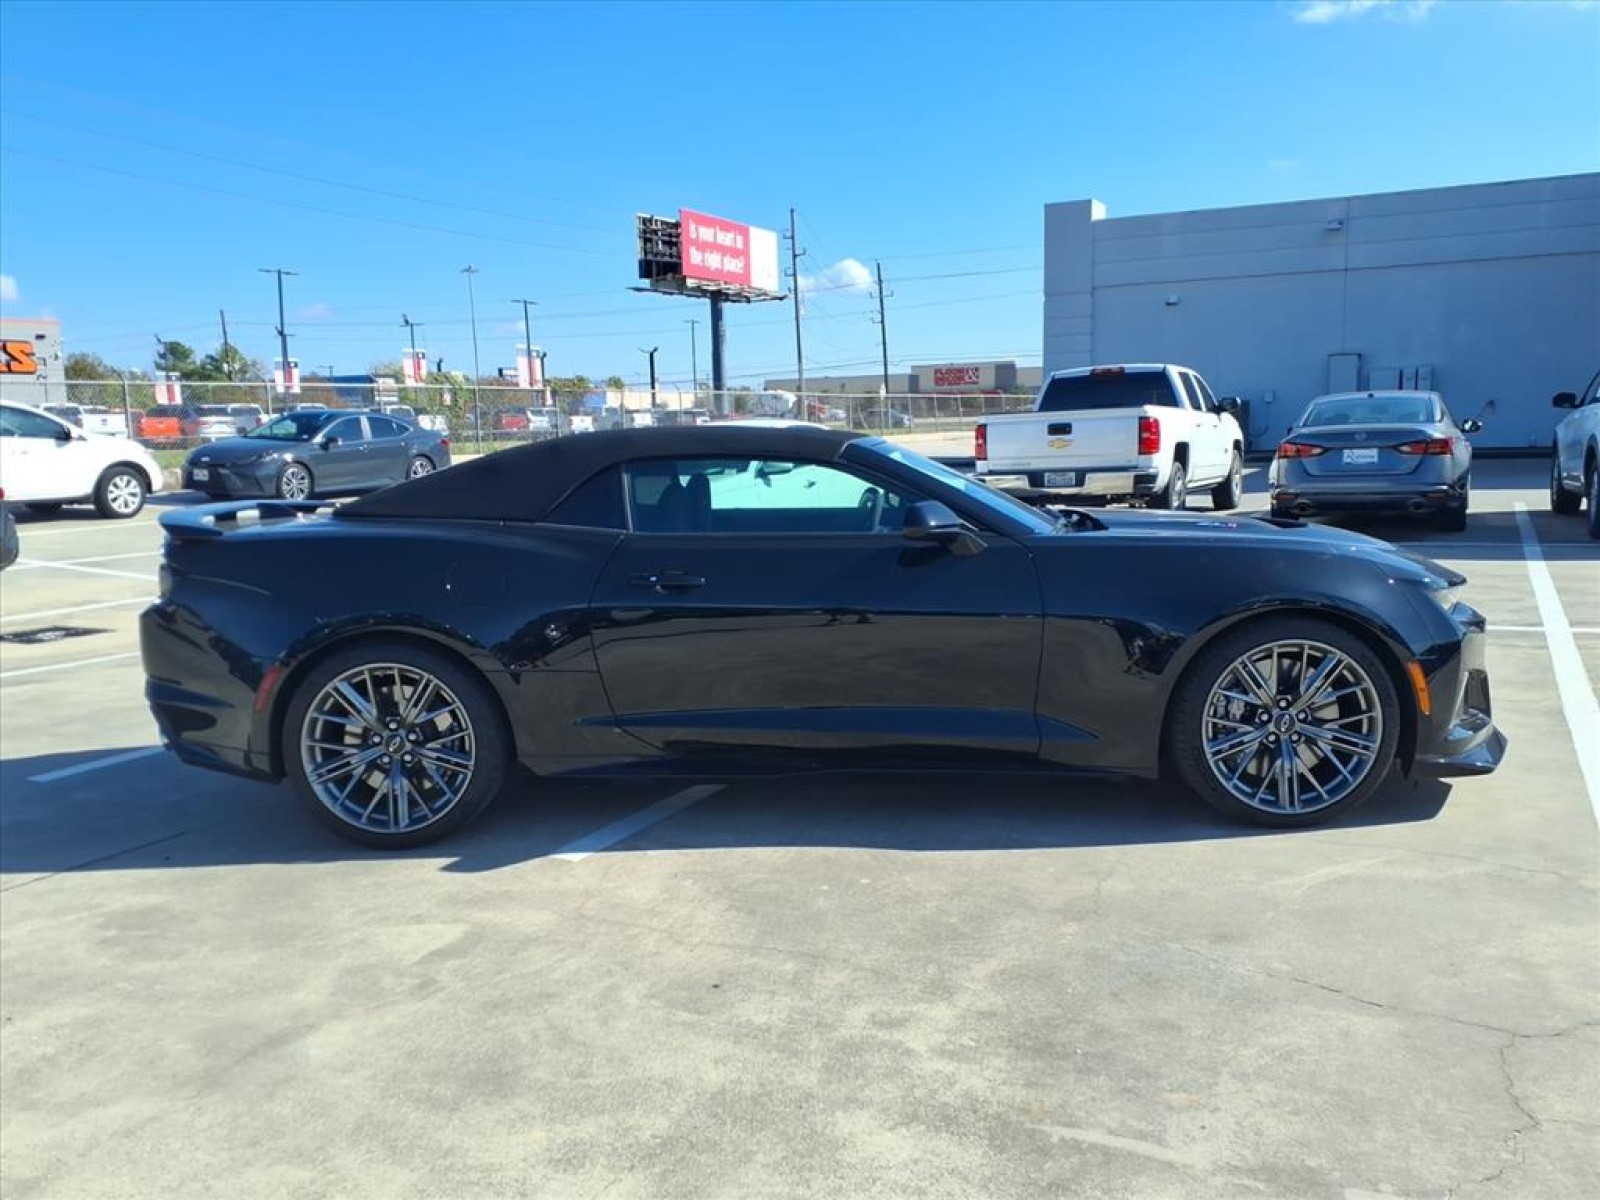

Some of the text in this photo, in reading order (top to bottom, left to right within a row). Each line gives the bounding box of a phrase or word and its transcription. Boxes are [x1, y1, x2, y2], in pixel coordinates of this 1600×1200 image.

[697, 225, 714, 243] your
[715, 225, 735, 247] heart
[689, 245, 744, 274] the right place?
